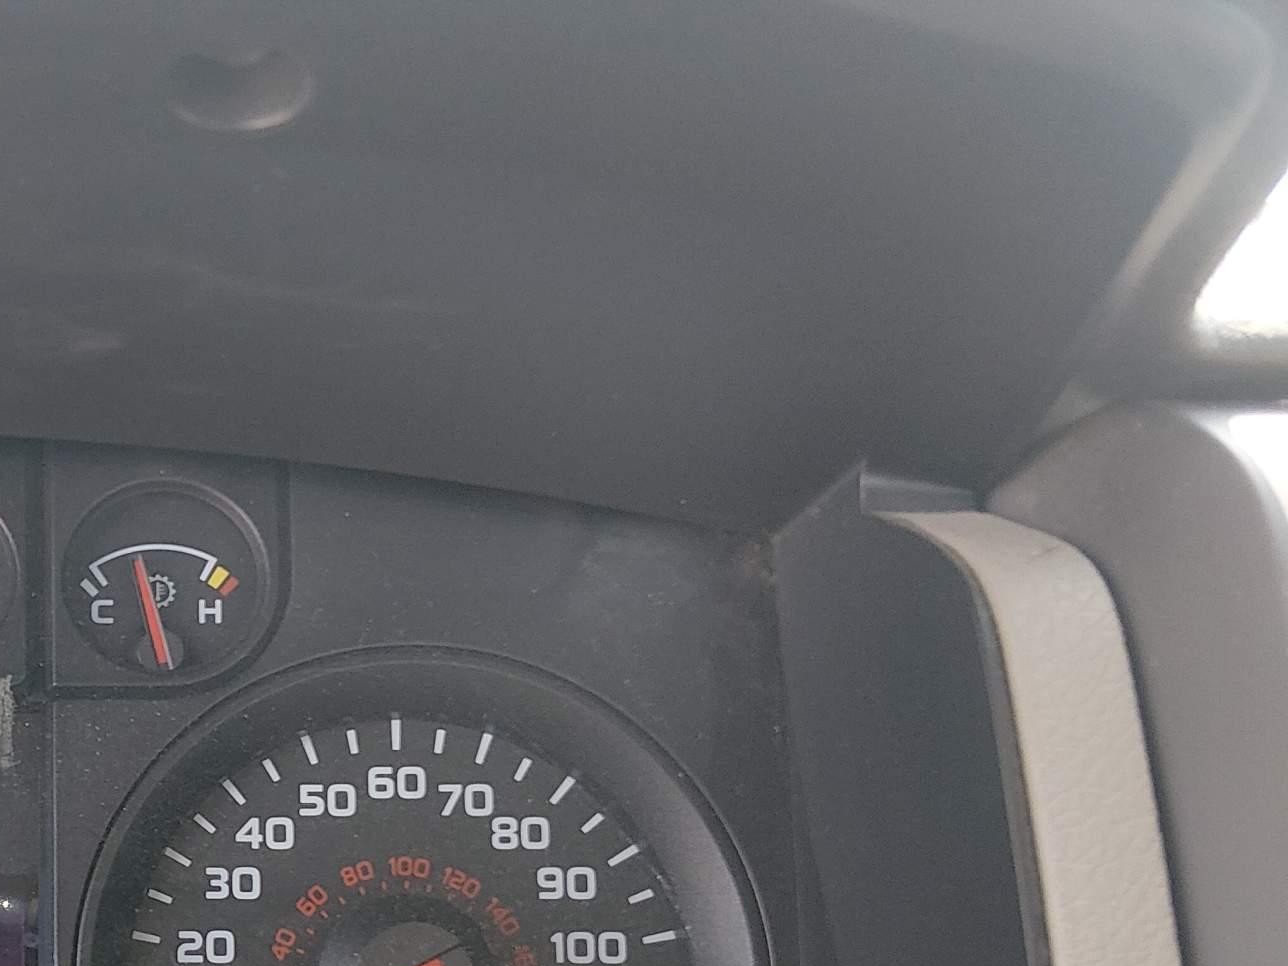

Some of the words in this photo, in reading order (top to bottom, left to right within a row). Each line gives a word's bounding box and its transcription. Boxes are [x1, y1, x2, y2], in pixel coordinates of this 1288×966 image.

[91, 600, 114, 624] C
[198, 600, 223, 625] H
[367, 766, 426, 799] 60
[297, 783, 357, 817] 50
[437, 783, 494, 817] 70
[234, 815, 295, 851] 40
[491, 815, 550, 851] 80
[204, 866, 261, 900] 30
[340, 859, 375, 887] 80
[388, 855, 431, 879] 100
[443, 866, 481, 898] 120
[536, 866, 597, 900] 90
[296, 885, 328, 917] 60
[176, 930, 235, 964] 20
[272, 928, 297, 961] 40
[550, 931, 627, 965] 100
